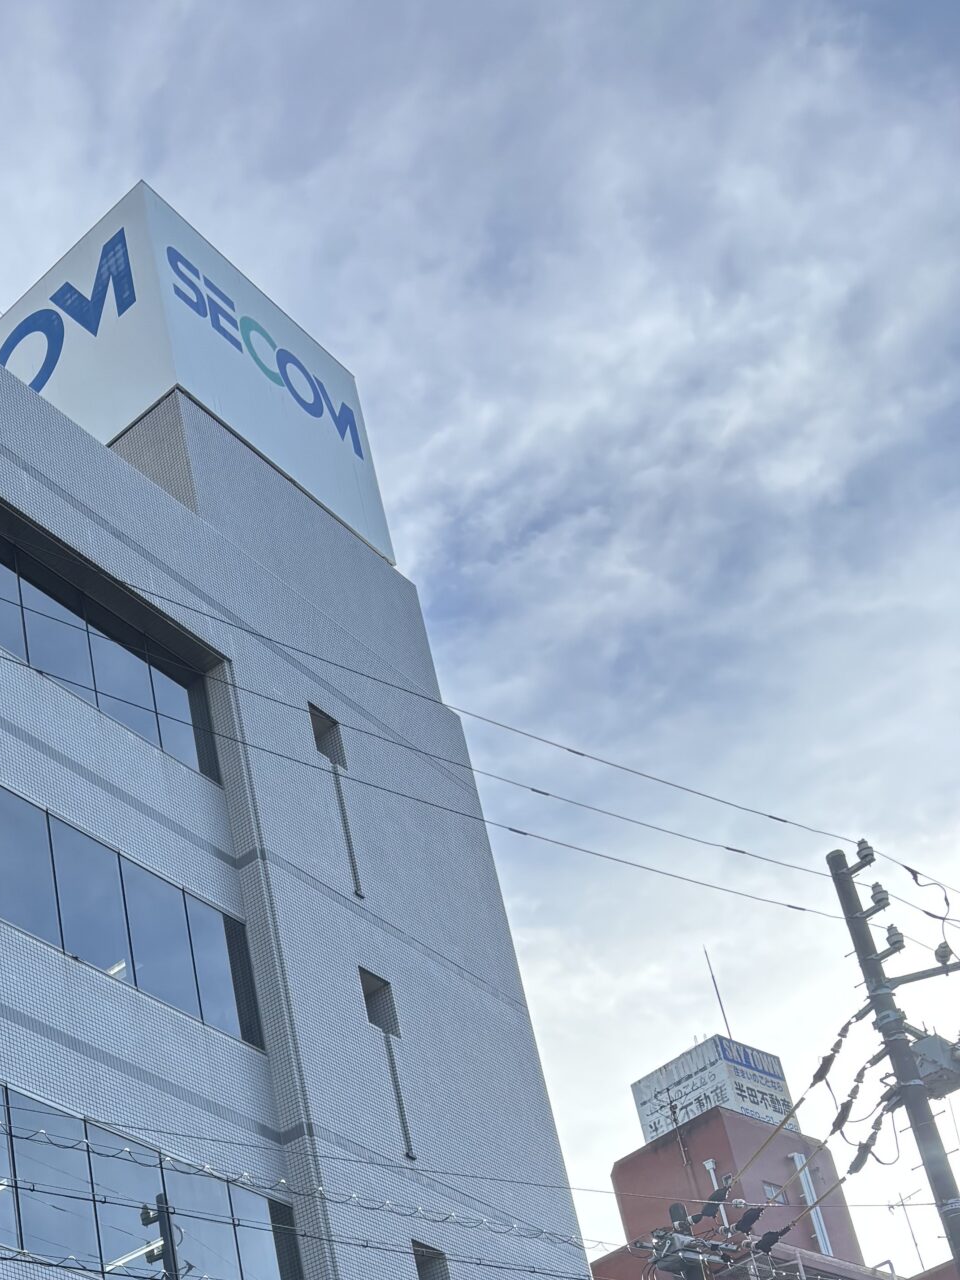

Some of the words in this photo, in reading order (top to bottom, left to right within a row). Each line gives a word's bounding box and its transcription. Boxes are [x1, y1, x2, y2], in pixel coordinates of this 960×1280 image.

[166, 246, 364, 461] SECOM
[722, 1039, 747, 1066] SKY
[744, 1047, 784, 1080] TOWN
[734, 1080, 794, 1116] 半田不動産
